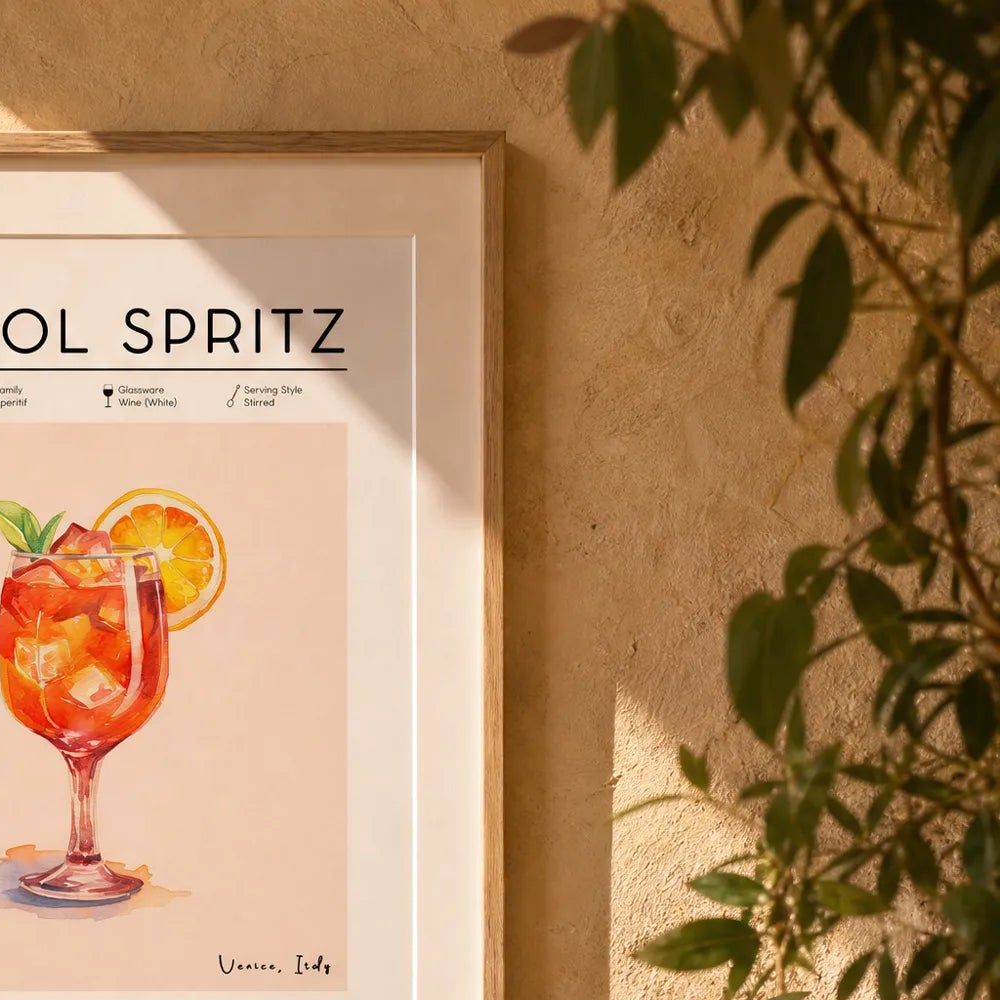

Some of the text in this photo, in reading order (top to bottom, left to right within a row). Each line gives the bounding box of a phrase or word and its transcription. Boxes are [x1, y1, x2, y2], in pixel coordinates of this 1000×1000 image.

[123, 308, 345, 354] SPRITZ
[118, 385, 165, 395] Glassware
[244, 385, 303, 396] Serving Style
[118, 397, 178, 409] Wine (White)
[244, 397, 275, 407] Stirred
[218, 954, 282, 975] Venice,
